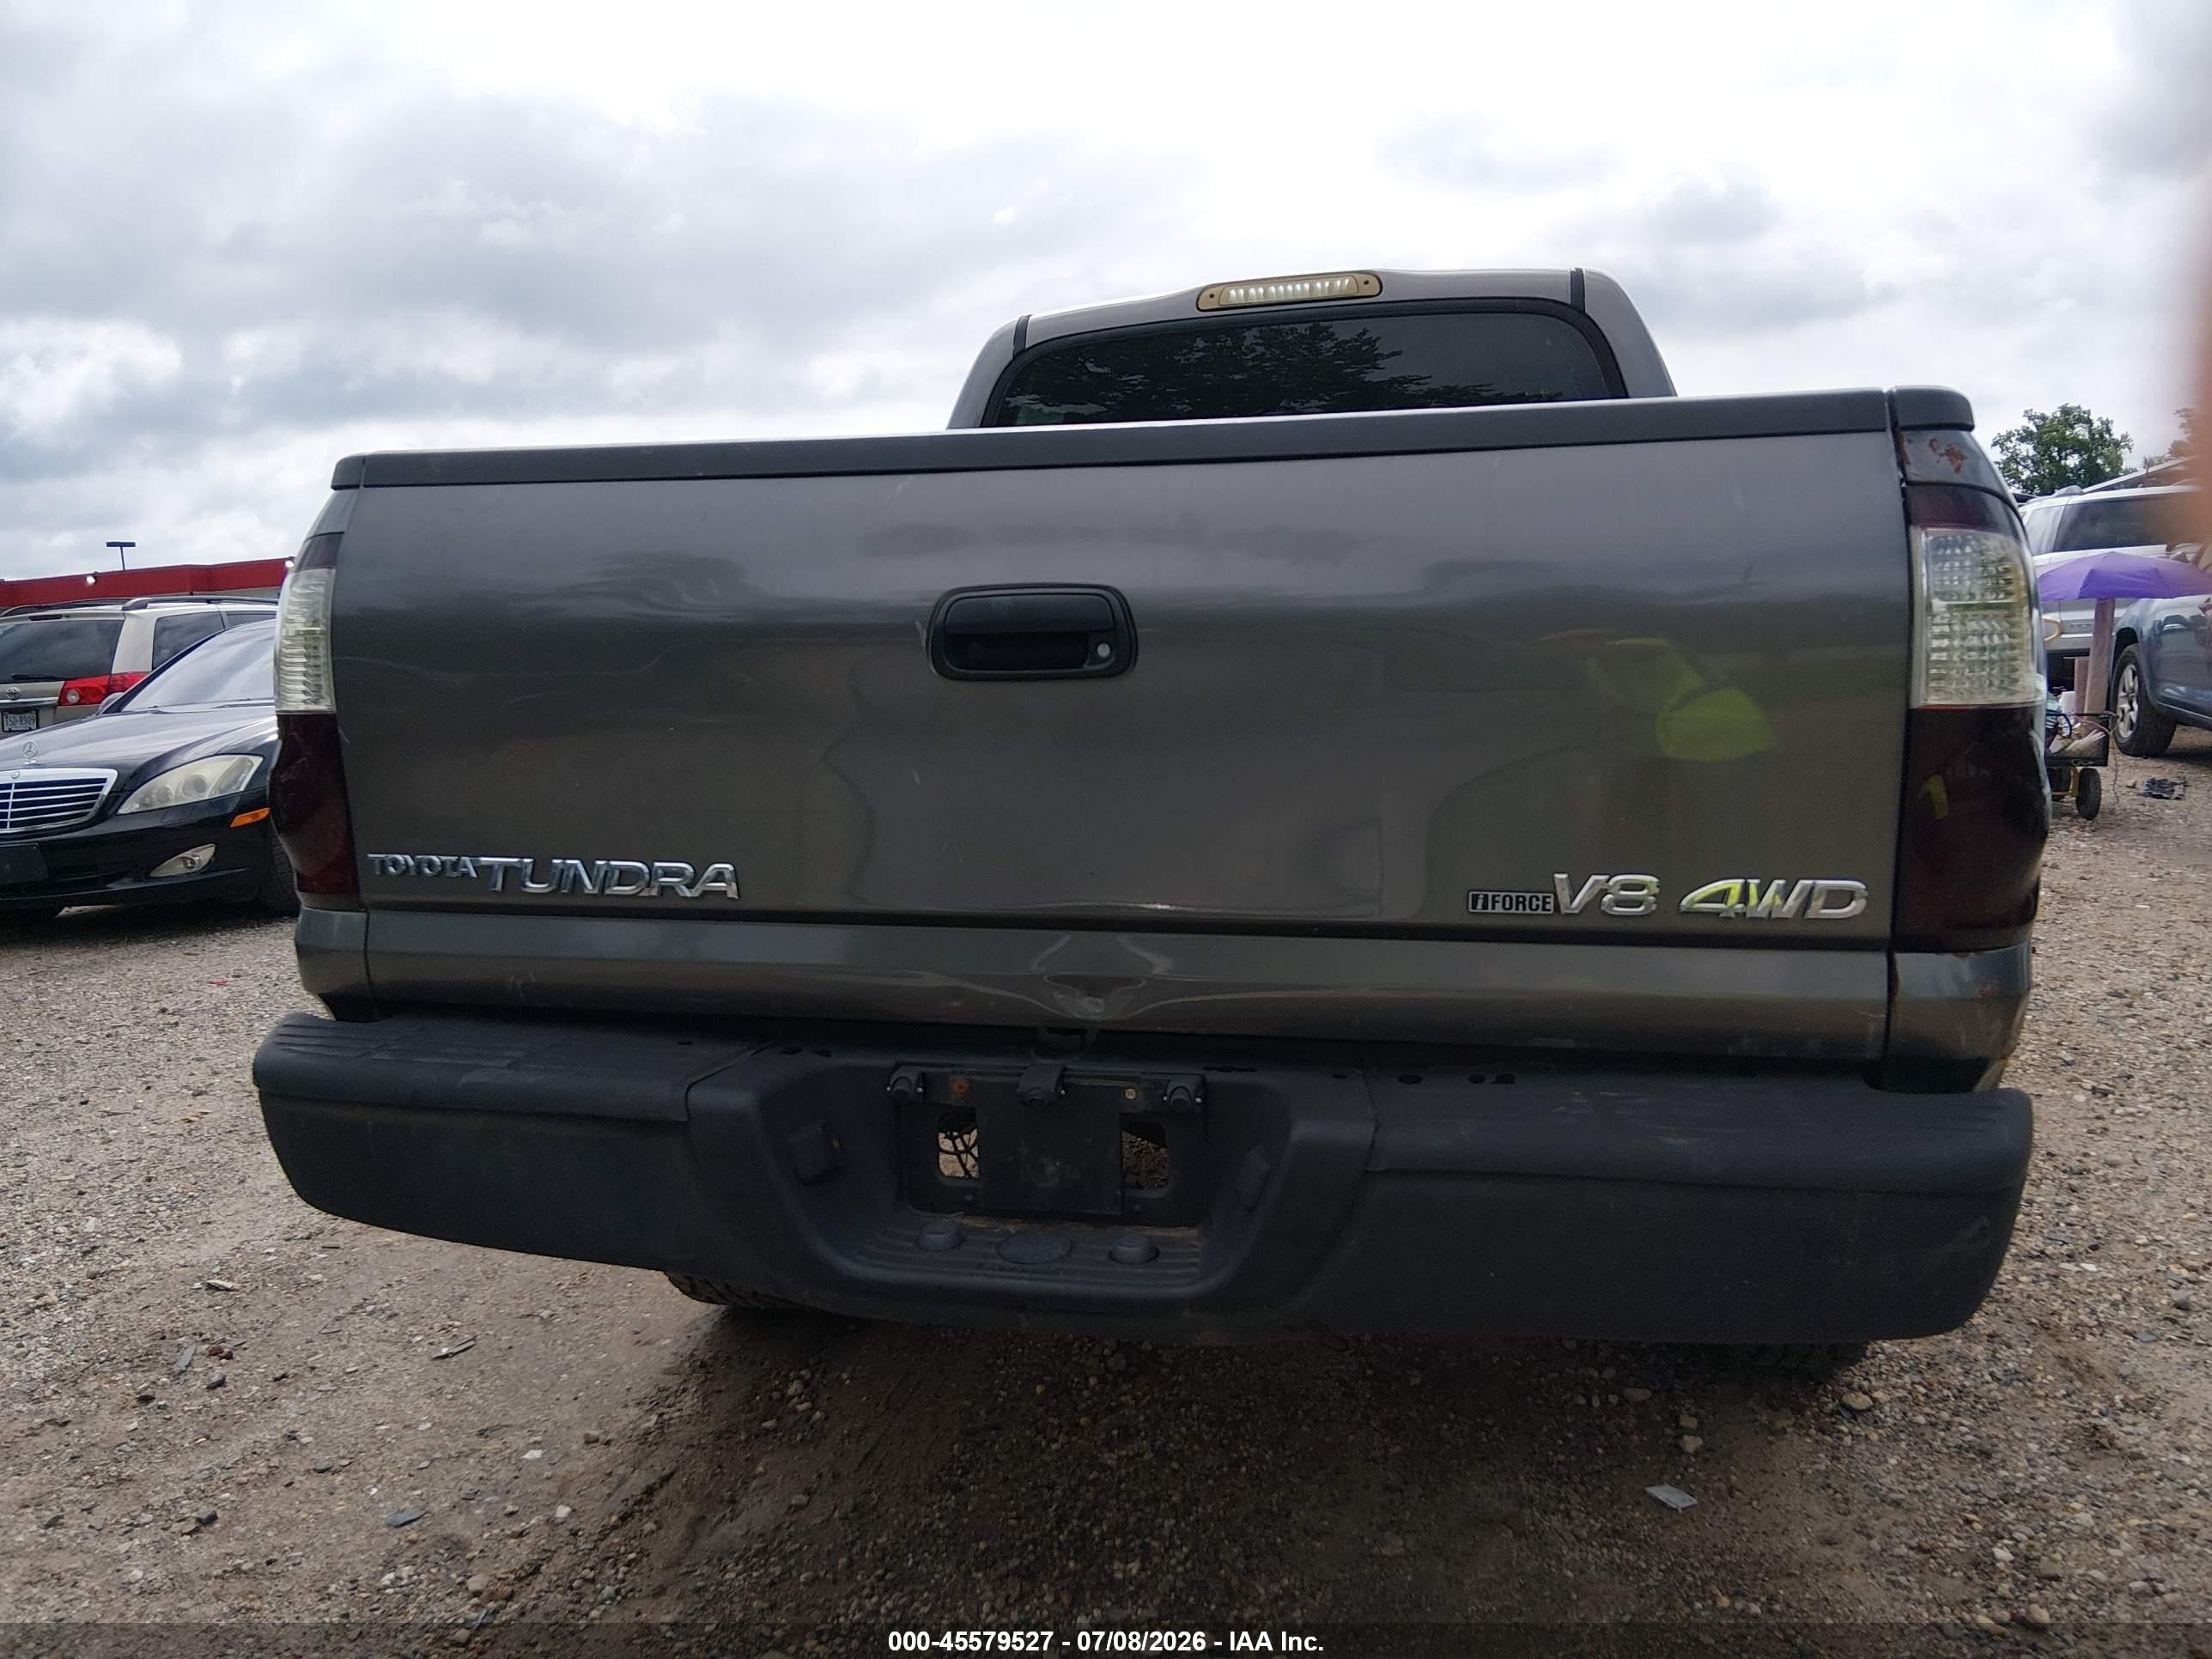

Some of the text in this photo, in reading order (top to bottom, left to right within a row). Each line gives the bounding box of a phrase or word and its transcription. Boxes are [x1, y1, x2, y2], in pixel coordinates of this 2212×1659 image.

[368, 854, 739, 899] TOYOTA TUNDRA
[1553, 872, 1660, 916] V8
[1679, 878, 1869, 920] 4WD
